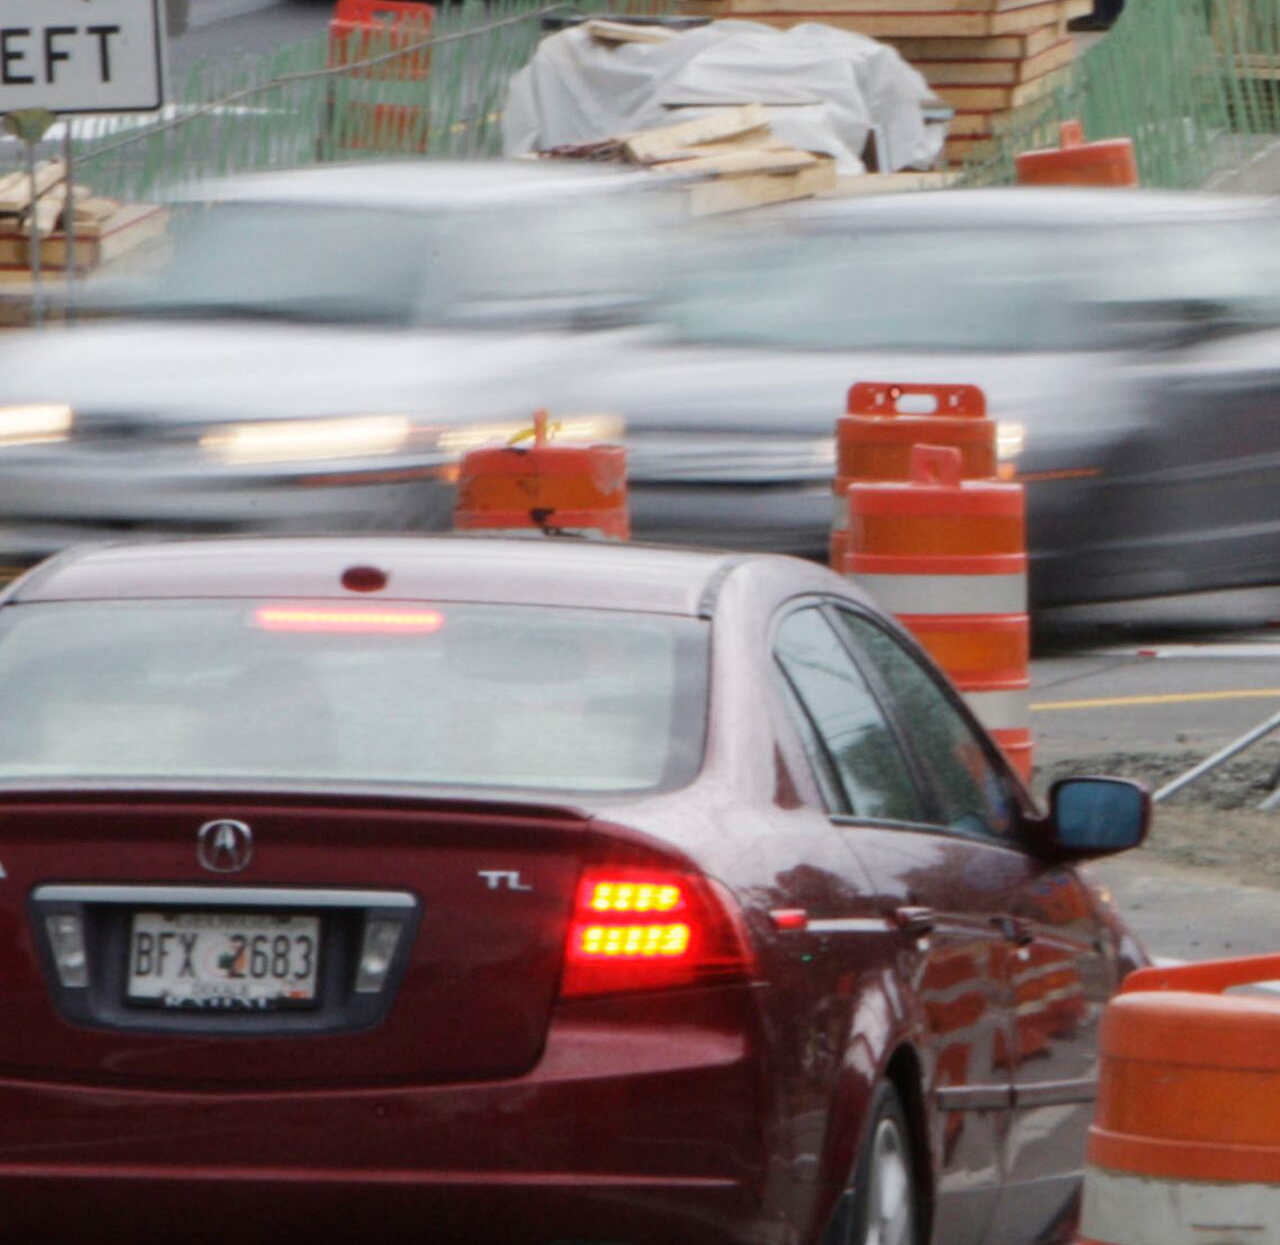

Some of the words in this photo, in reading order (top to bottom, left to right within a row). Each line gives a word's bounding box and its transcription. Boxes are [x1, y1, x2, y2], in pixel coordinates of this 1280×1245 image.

[0, 25, 120, 84] EFT
[478, 870, 533, 891] TL
[135, 931, 198, 978] BFX
[228, 934, 313, 981] 2683
